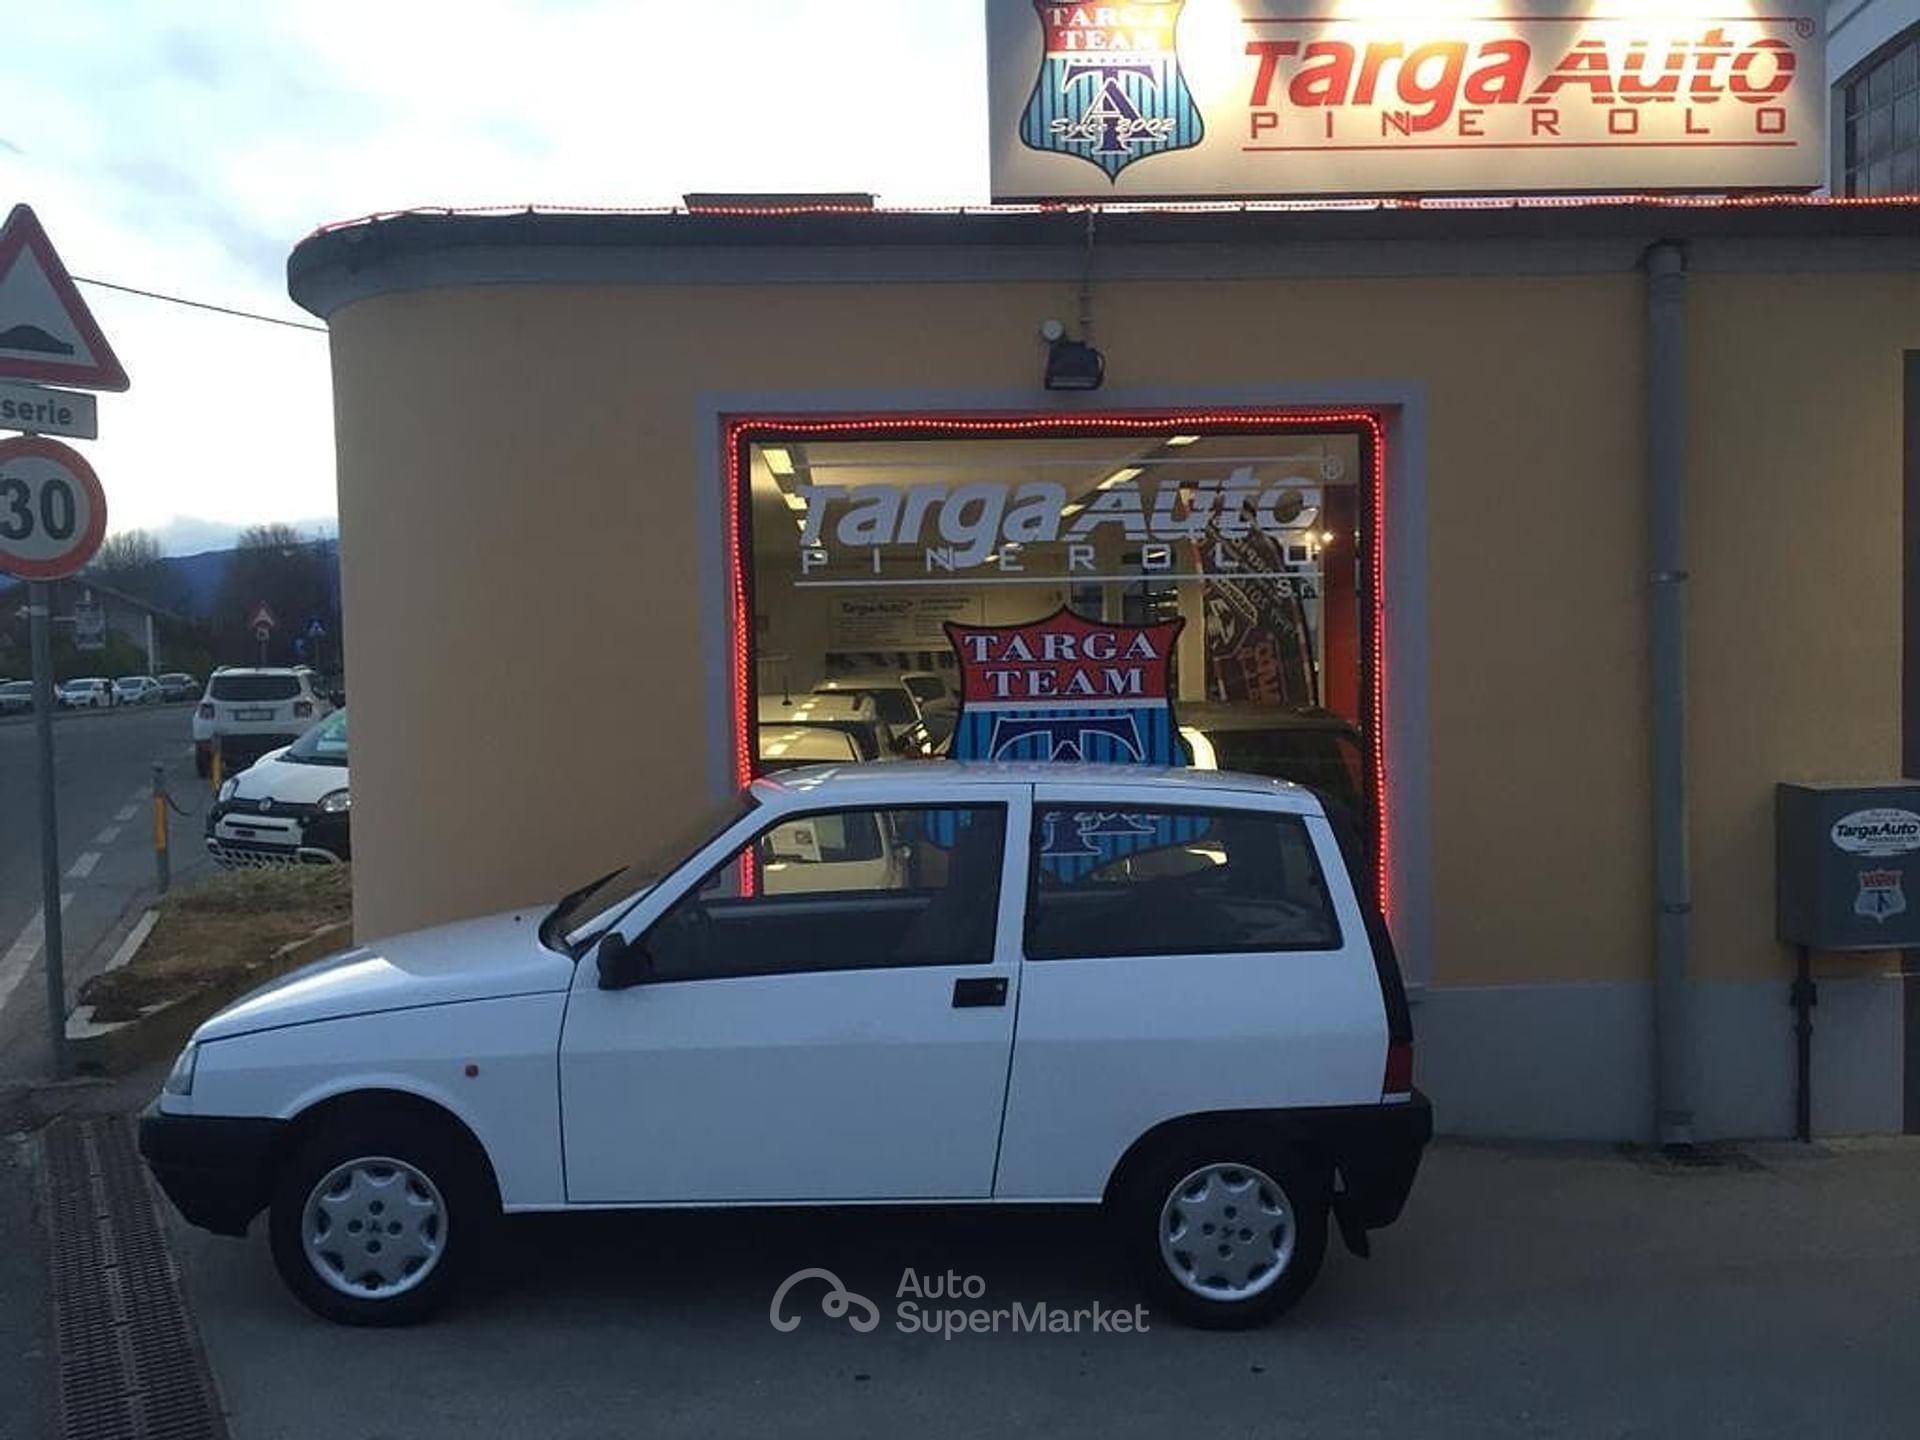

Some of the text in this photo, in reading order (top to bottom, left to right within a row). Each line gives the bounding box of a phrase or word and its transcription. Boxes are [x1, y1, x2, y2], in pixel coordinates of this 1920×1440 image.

[1251, 108, 1787, 139] PINEROLO
[2, 398, 72, 425] serie
[0, 478, 76, 541] 30
[802, 544, 1318, 575] PINEROLO
[965, 632, 1159, 662] TARGA
[986, 668, 1143, 697] TEAM
